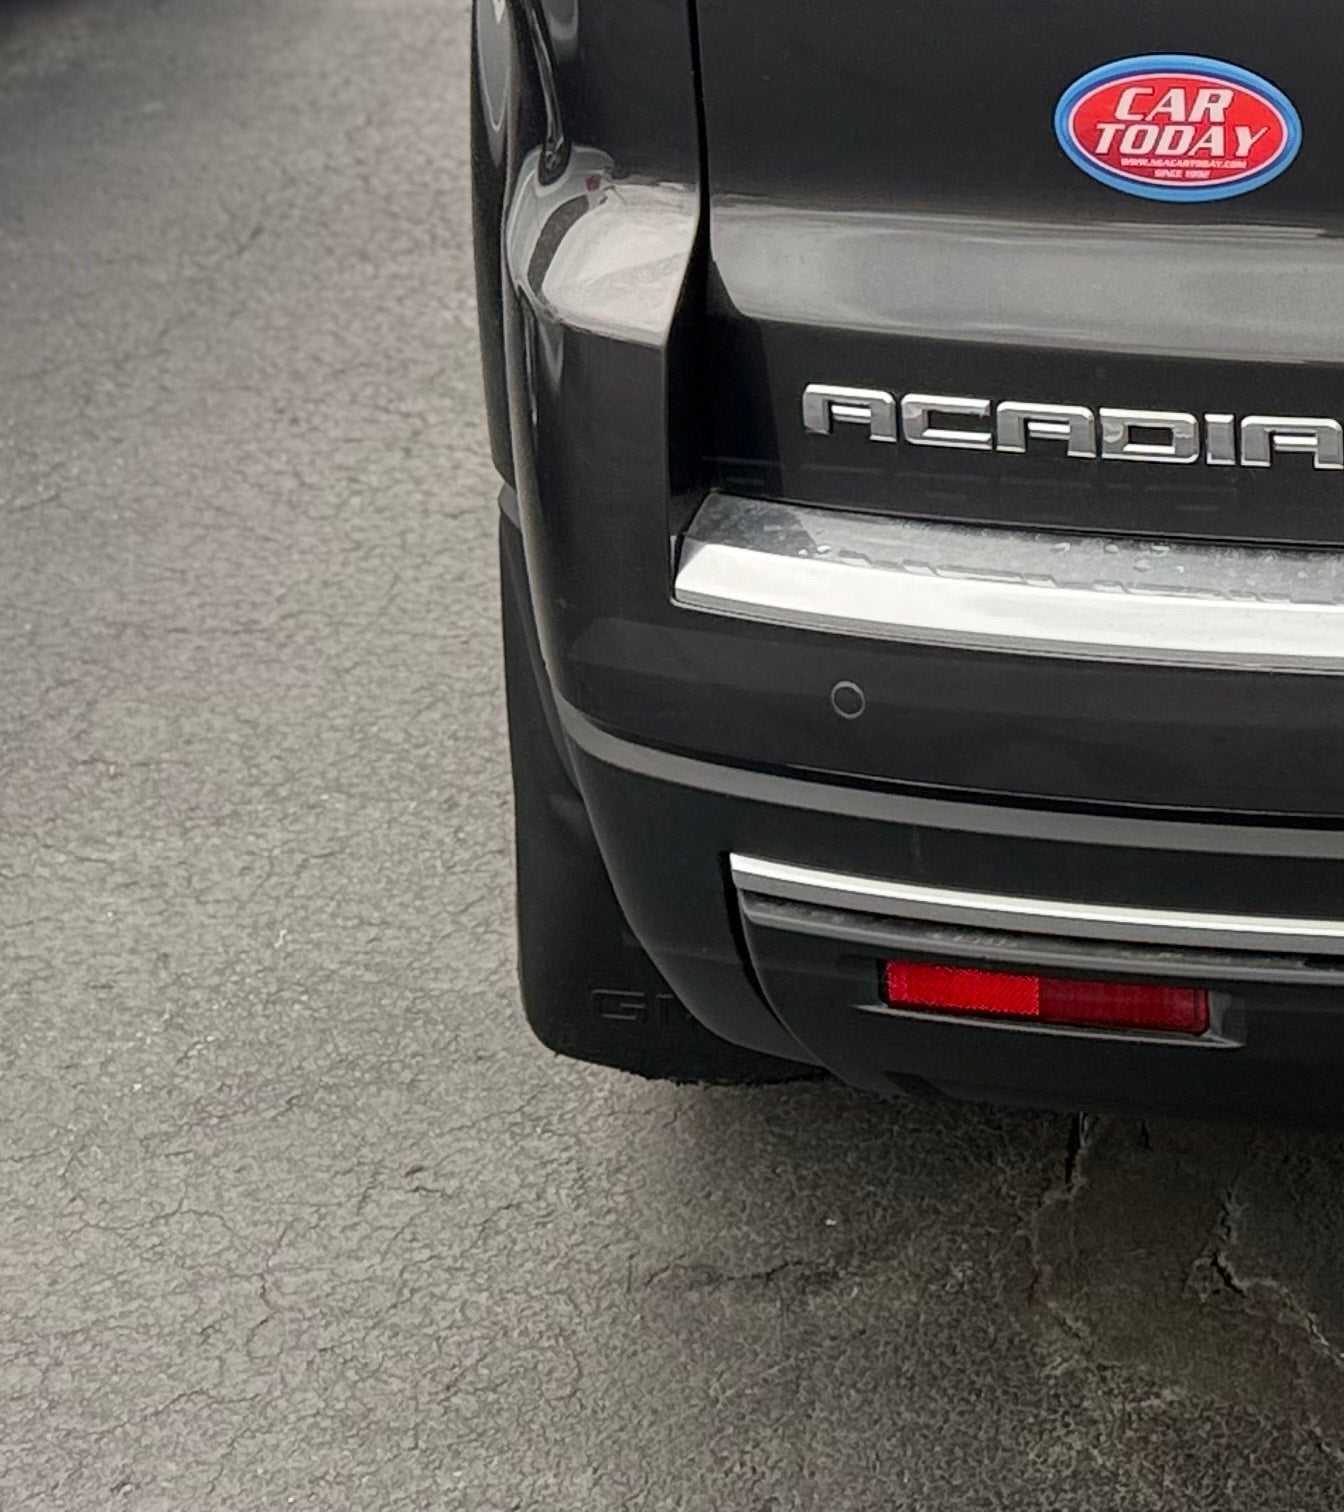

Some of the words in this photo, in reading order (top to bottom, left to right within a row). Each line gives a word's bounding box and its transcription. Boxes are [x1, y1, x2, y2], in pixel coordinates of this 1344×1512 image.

[1114, 87, 1234, 123] CAR
[1094, 123, 1268, 157] TODAY
[802, 383, 1344, 470] ACADIA
